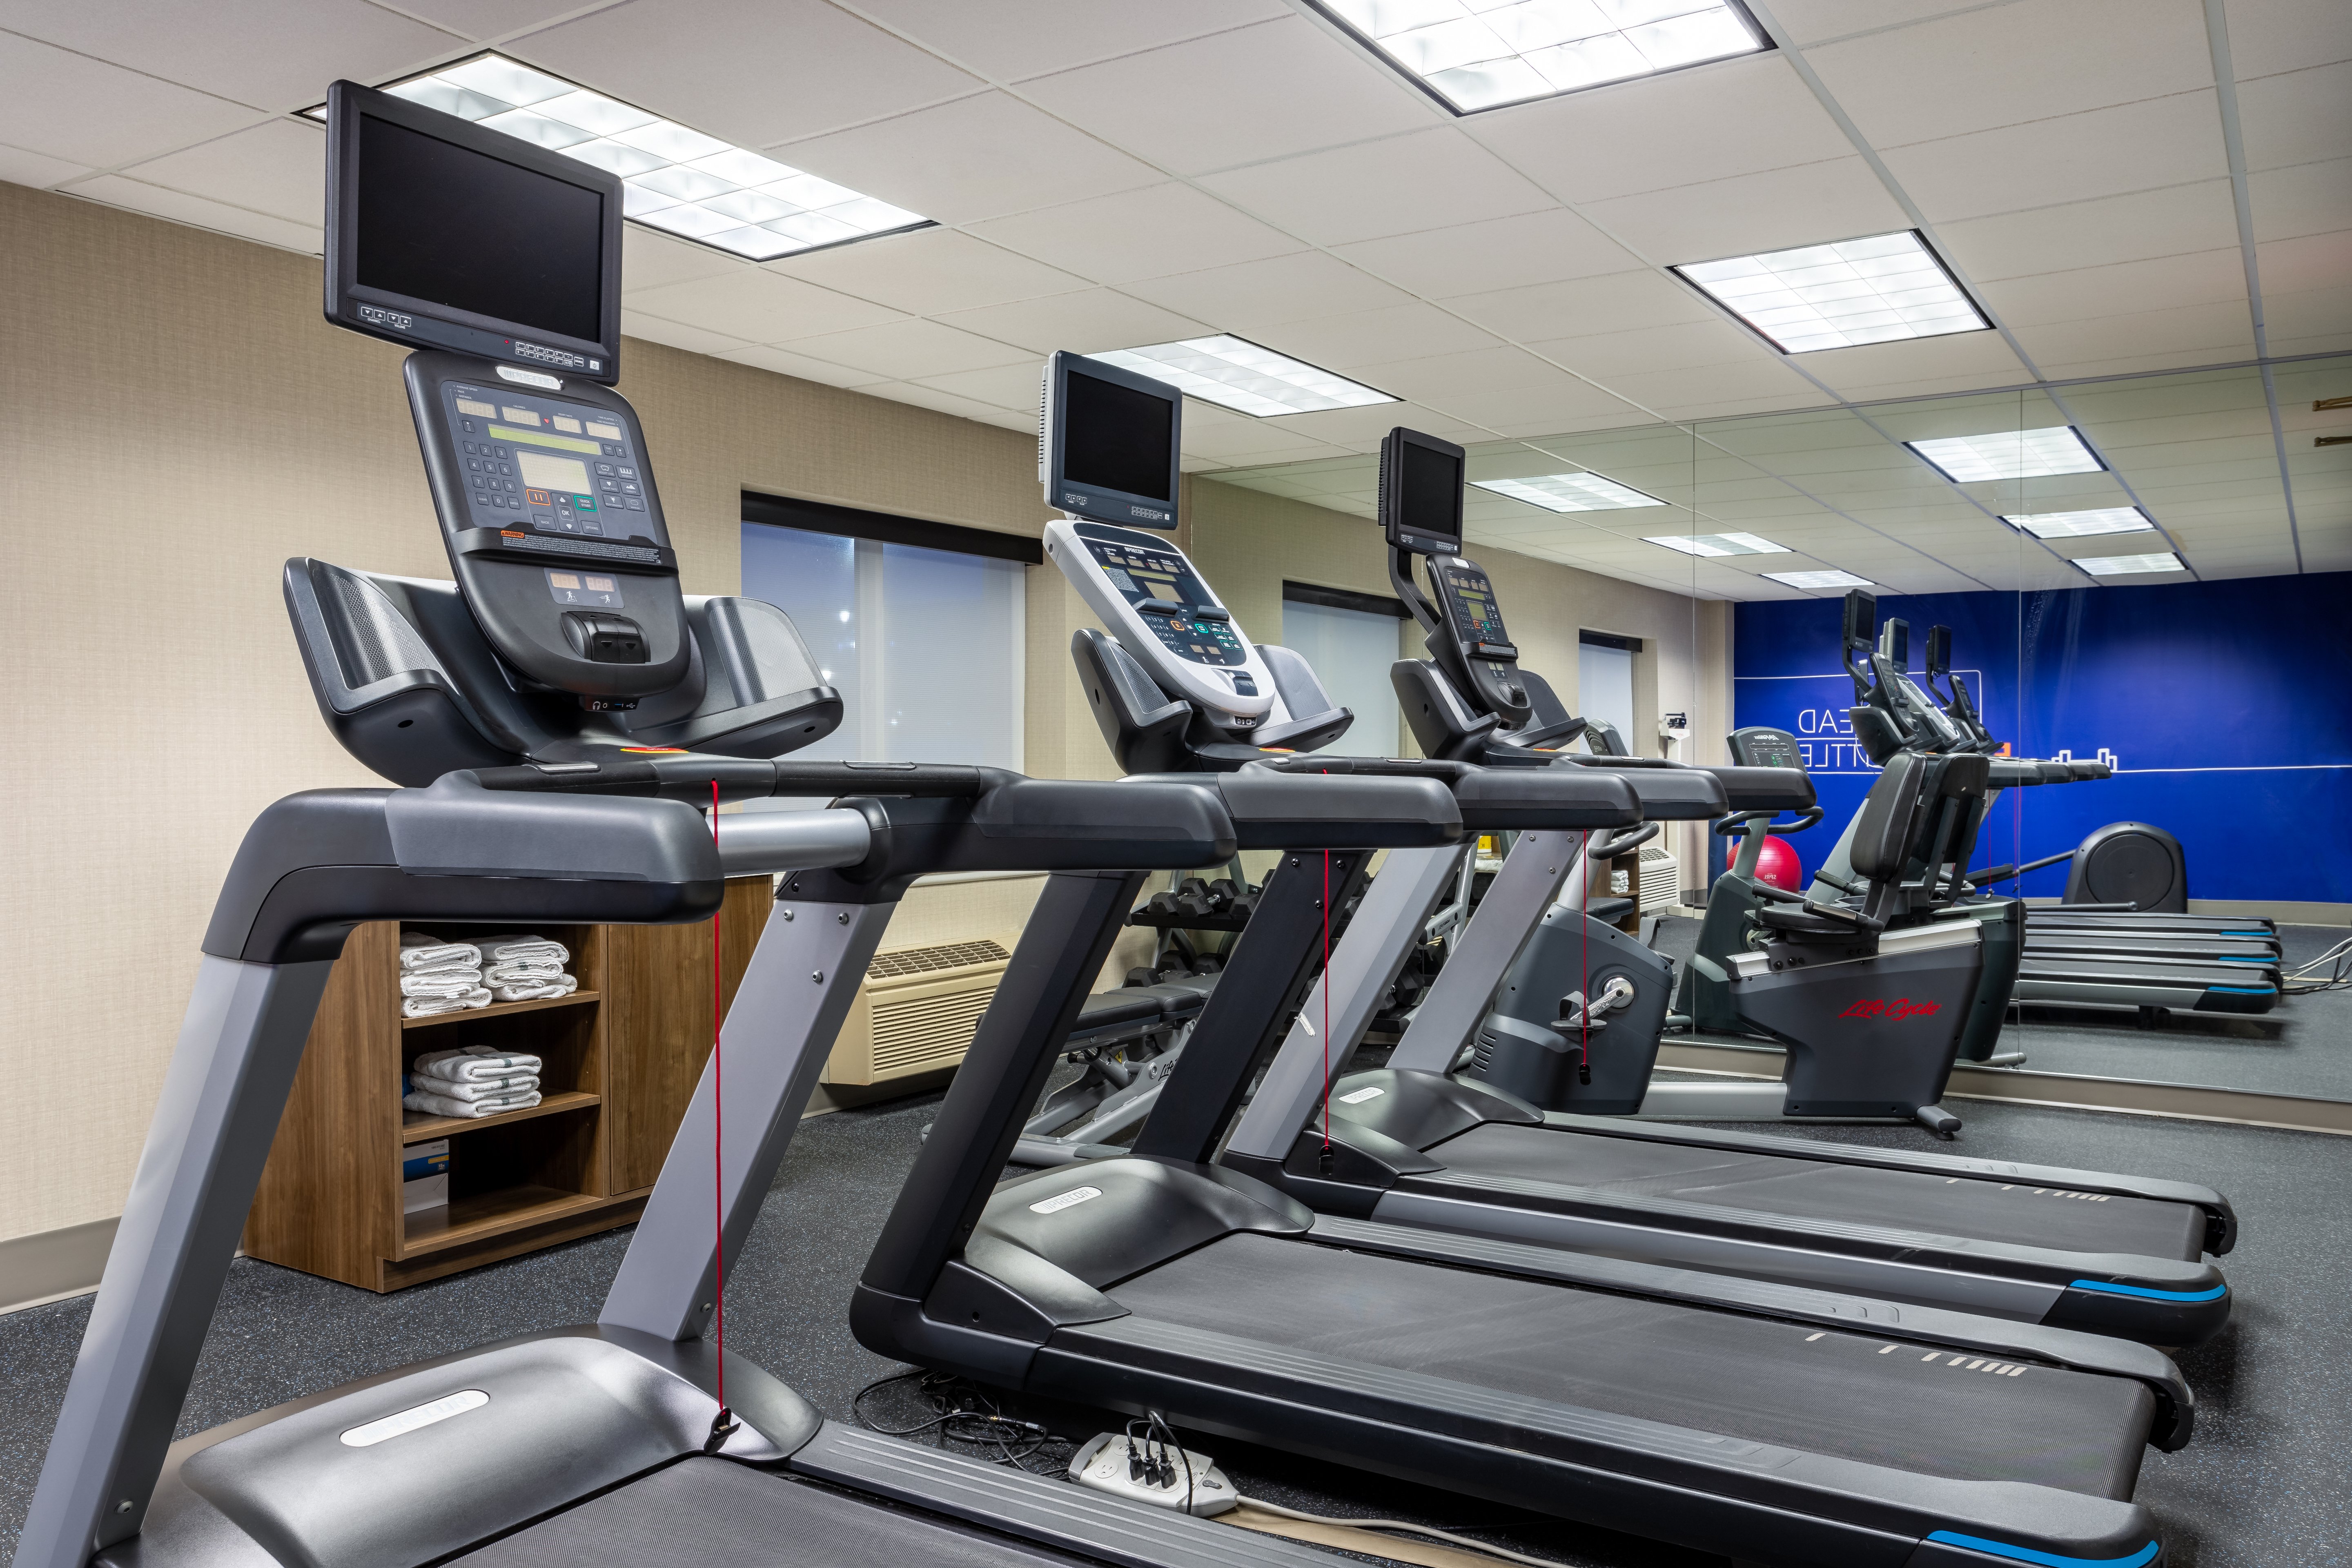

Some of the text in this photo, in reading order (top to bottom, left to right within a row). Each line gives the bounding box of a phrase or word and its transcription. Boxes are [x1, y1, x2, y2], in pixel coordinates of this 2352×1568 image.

[510, 370, 555, 387] PRECOR
[1838, 998, 1942, 1021] Life Cycle
[1158, 1060, 1174, 1082] Life
[1349, 1089, 1379, 1101] PRECOR
[1048, 1189, 1093, 1209] PRECOR
[378, 1395, 470, 1436] PRECOR
